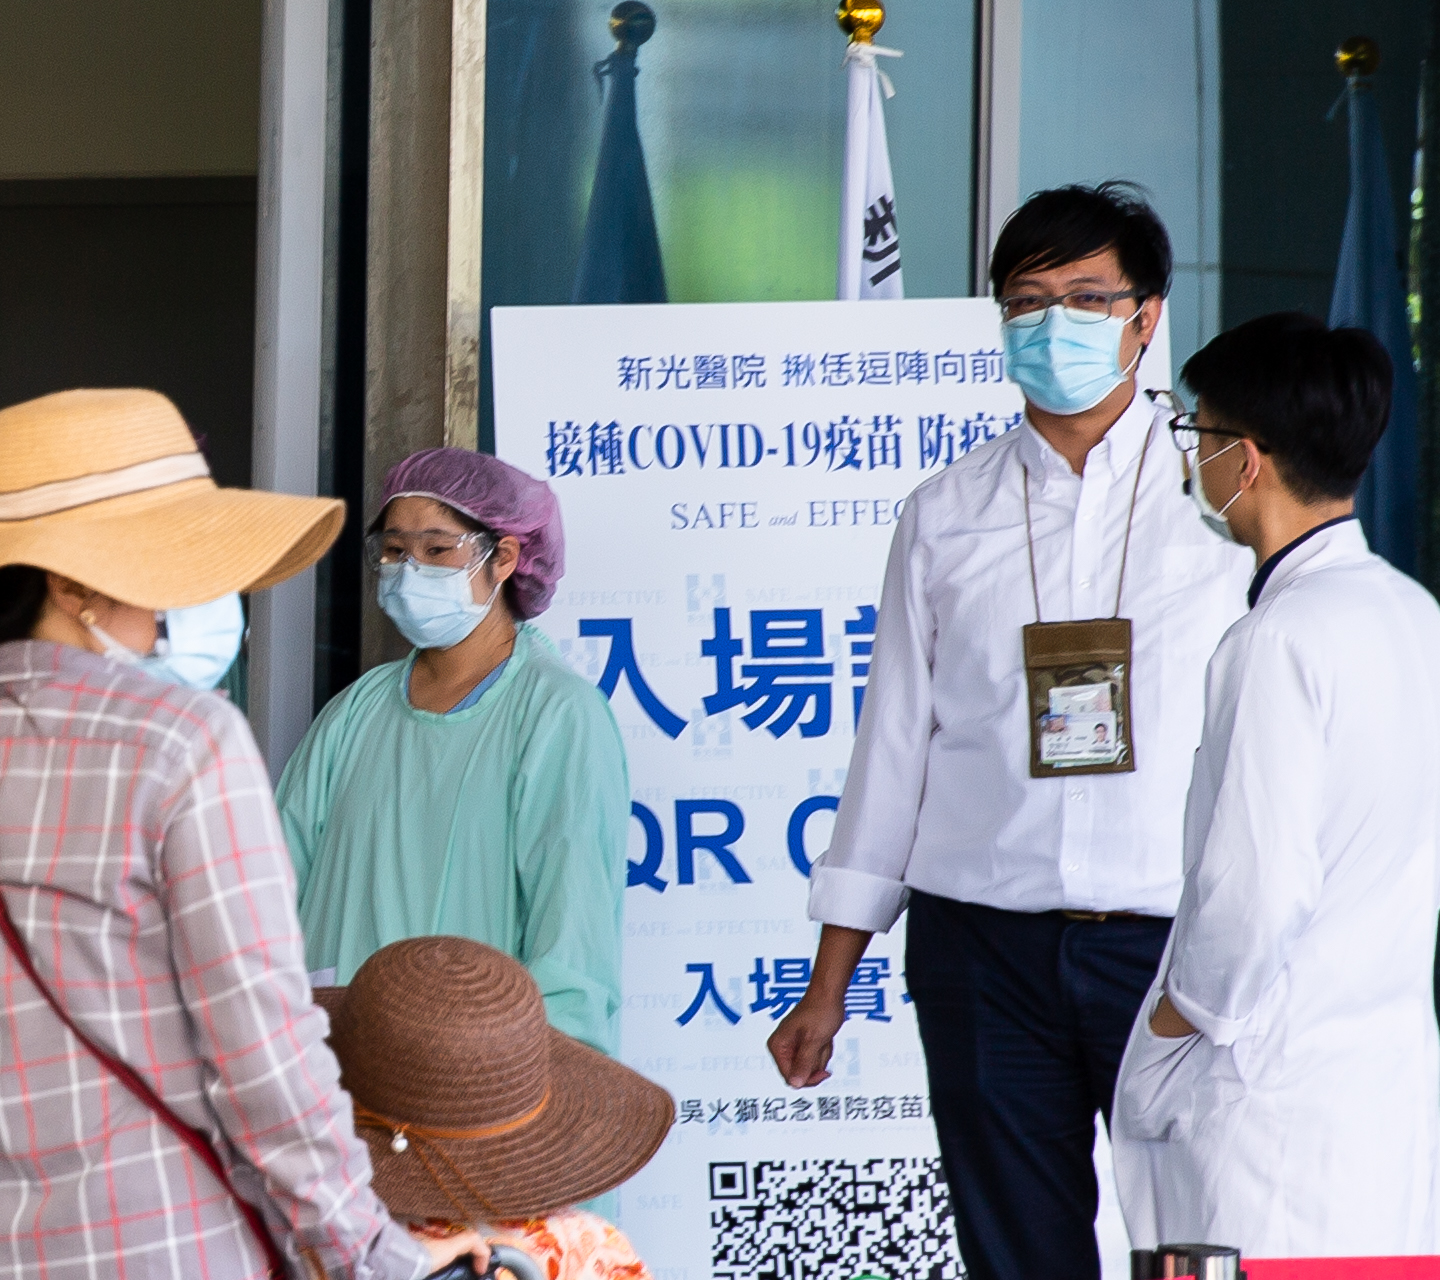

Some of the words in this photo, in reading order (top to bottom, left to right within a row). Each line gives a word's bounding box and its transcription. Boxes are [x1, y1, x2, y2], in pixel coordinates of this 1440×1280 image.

[617, 354, 768, 391] 新光醫院
[781, 348, 1004, 388] 揪恁逗陣向前
[544, 413, 903, 478] 接種COVID-19疫苗
[918, 411, 1023, 470] 防疫
[670, 501, 759, 530] SAFE
[768, 510, 797, 526] and
[626, 798, 754, 894] QR
[675, 956, 913, 1027] 入場實
[676, 1094, 933, 1124] 吳火獅紀念醫院疫苗
